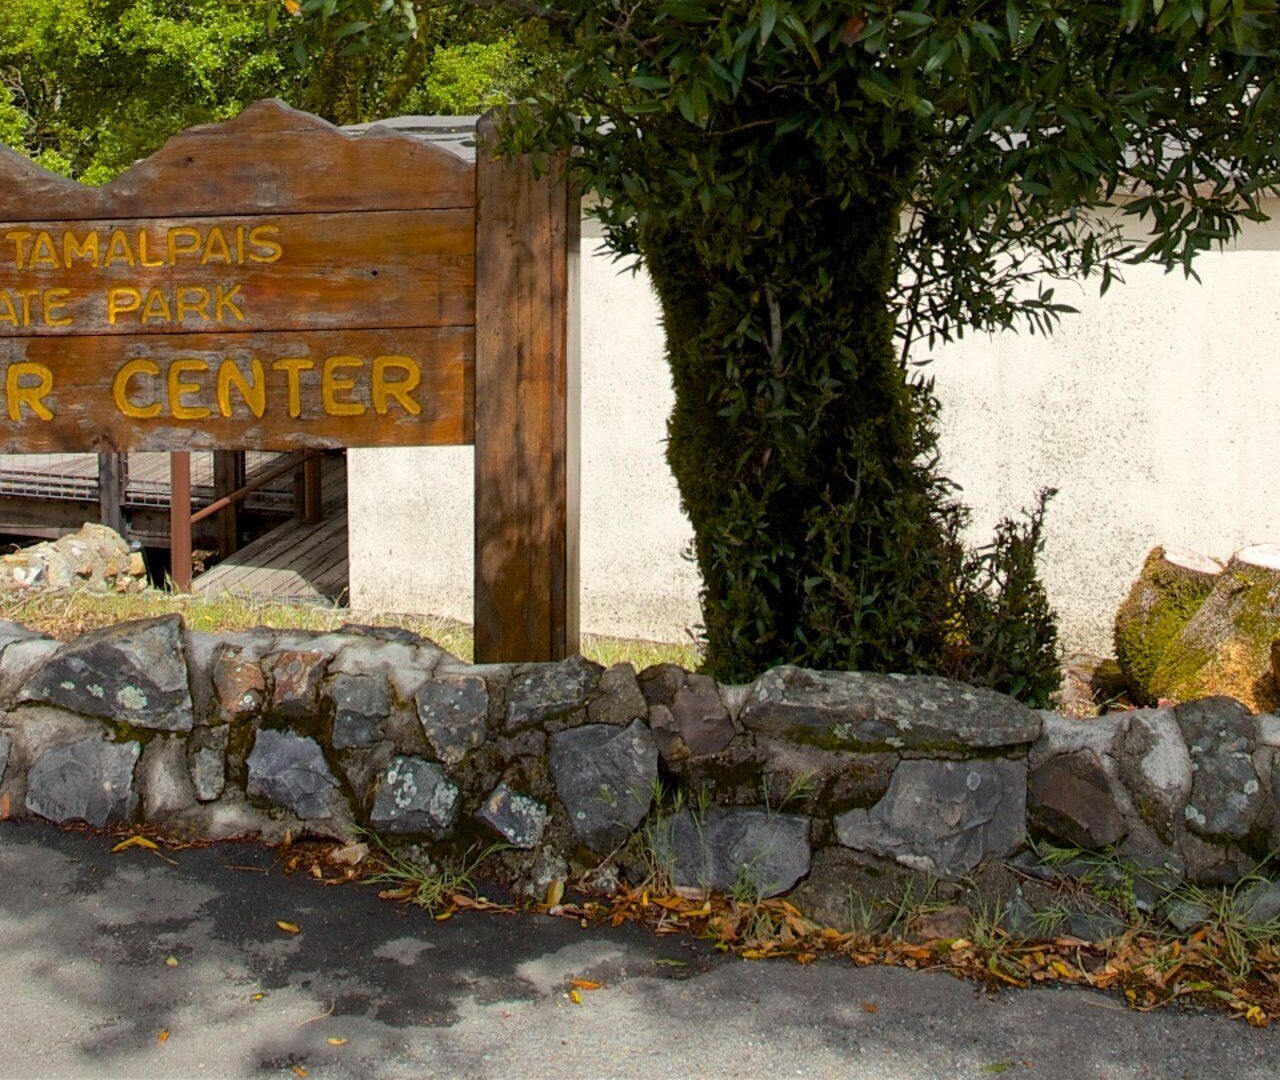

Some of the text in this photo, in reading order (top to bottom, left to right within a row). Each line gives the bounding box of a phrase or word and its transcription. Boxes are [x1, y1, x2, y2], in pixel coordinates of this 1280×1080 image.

[5, 224, 284, 271] TAMALPAIS
[107, 282, 246, 325] PARK
[114, 353, 423, 420] CENTER
